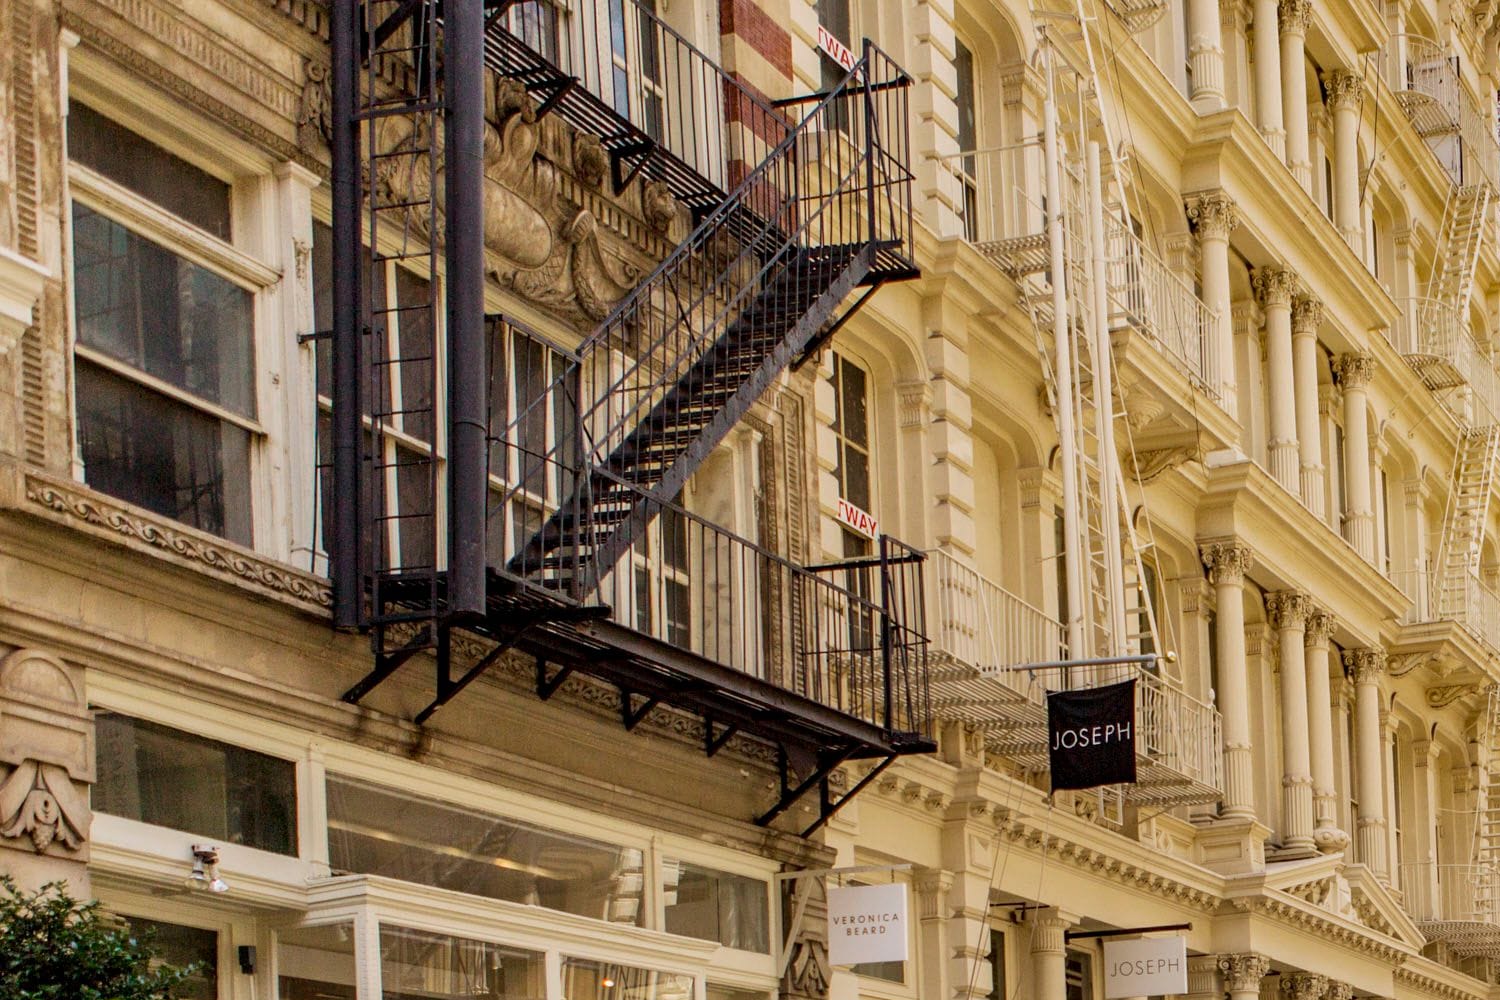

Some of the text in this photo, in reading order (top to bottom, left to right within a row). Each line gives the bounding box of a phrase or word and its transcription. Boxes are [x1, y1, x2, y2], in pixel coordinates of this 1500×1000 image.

[1053, 721, 1131, 751] JOSEPH
[832, 913, 899, 925] VERONICA
[846, 925, 886, 936] BEARD
[1110, 958, 1179, 978] JOSEPH
